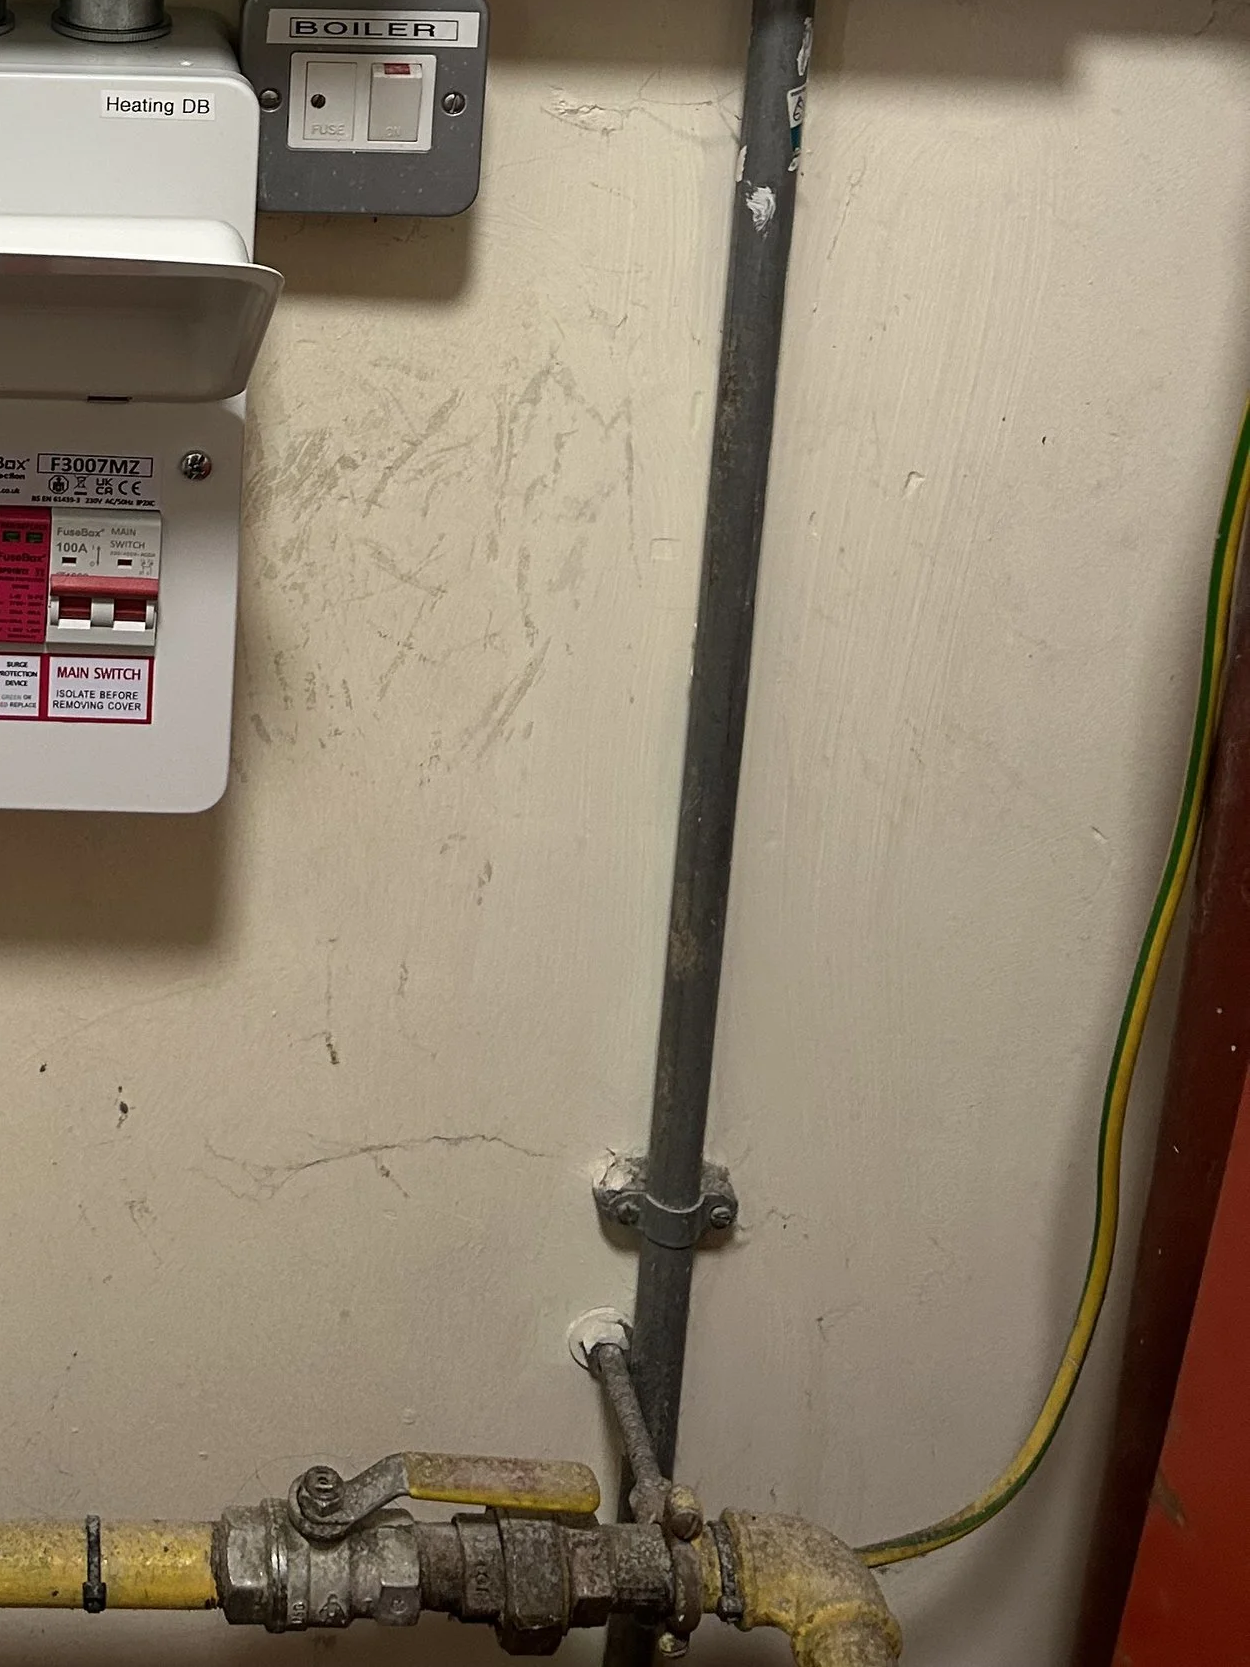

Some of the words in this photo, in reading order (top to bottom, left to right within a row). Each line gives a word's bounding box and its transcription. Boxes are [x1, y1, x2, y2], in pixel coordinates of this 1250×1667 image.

[294, 20, 436, 38] BOILER
[106, 96, 175, 116] Heating
[182, 98, 210, 115] DB
[50, 456, 141, 475] F3007MZ
[57, 527, 100, 537] FuseBox
[111, 528, 136, 536] MAIN
[56, 542, 87, 553] 100A
[110, 540, 145, 549] SWITCH
[57, 666, 89, 679] MAIN
[94, 667, 141, 681] SWITCH
[56, 689, 96, 699] ISOLATE
[99, 691, 139, 700] BEFORE
[52, 700, 104, 710] REMOVING
[108, 701, 141, 711] COVER
